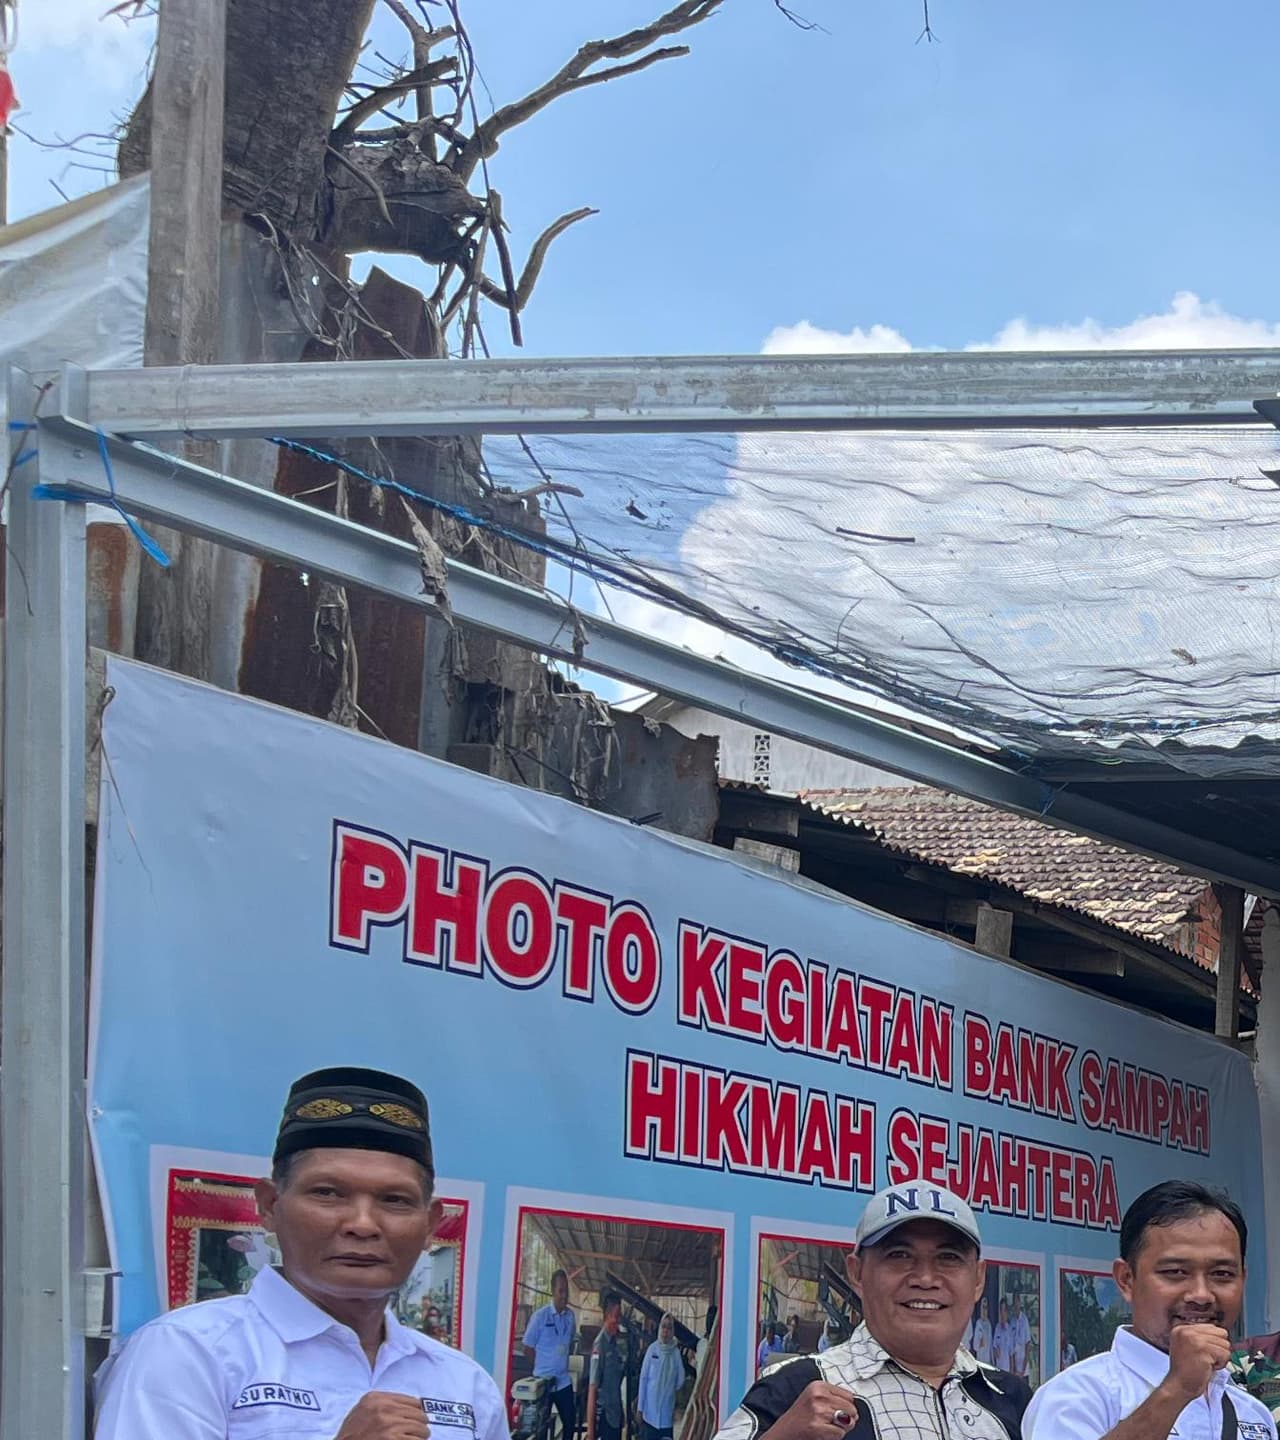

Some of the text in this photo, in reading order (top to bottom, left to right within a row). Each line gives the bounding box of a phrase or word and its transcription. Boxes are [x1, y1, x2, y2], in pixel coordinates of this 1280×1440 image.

[329, 818, 1211, 1157] PHOTO KEGIATAN BANK SAMPAH
[624, 1048, 1122, 1233] HIKMAH SEJAHTERA
